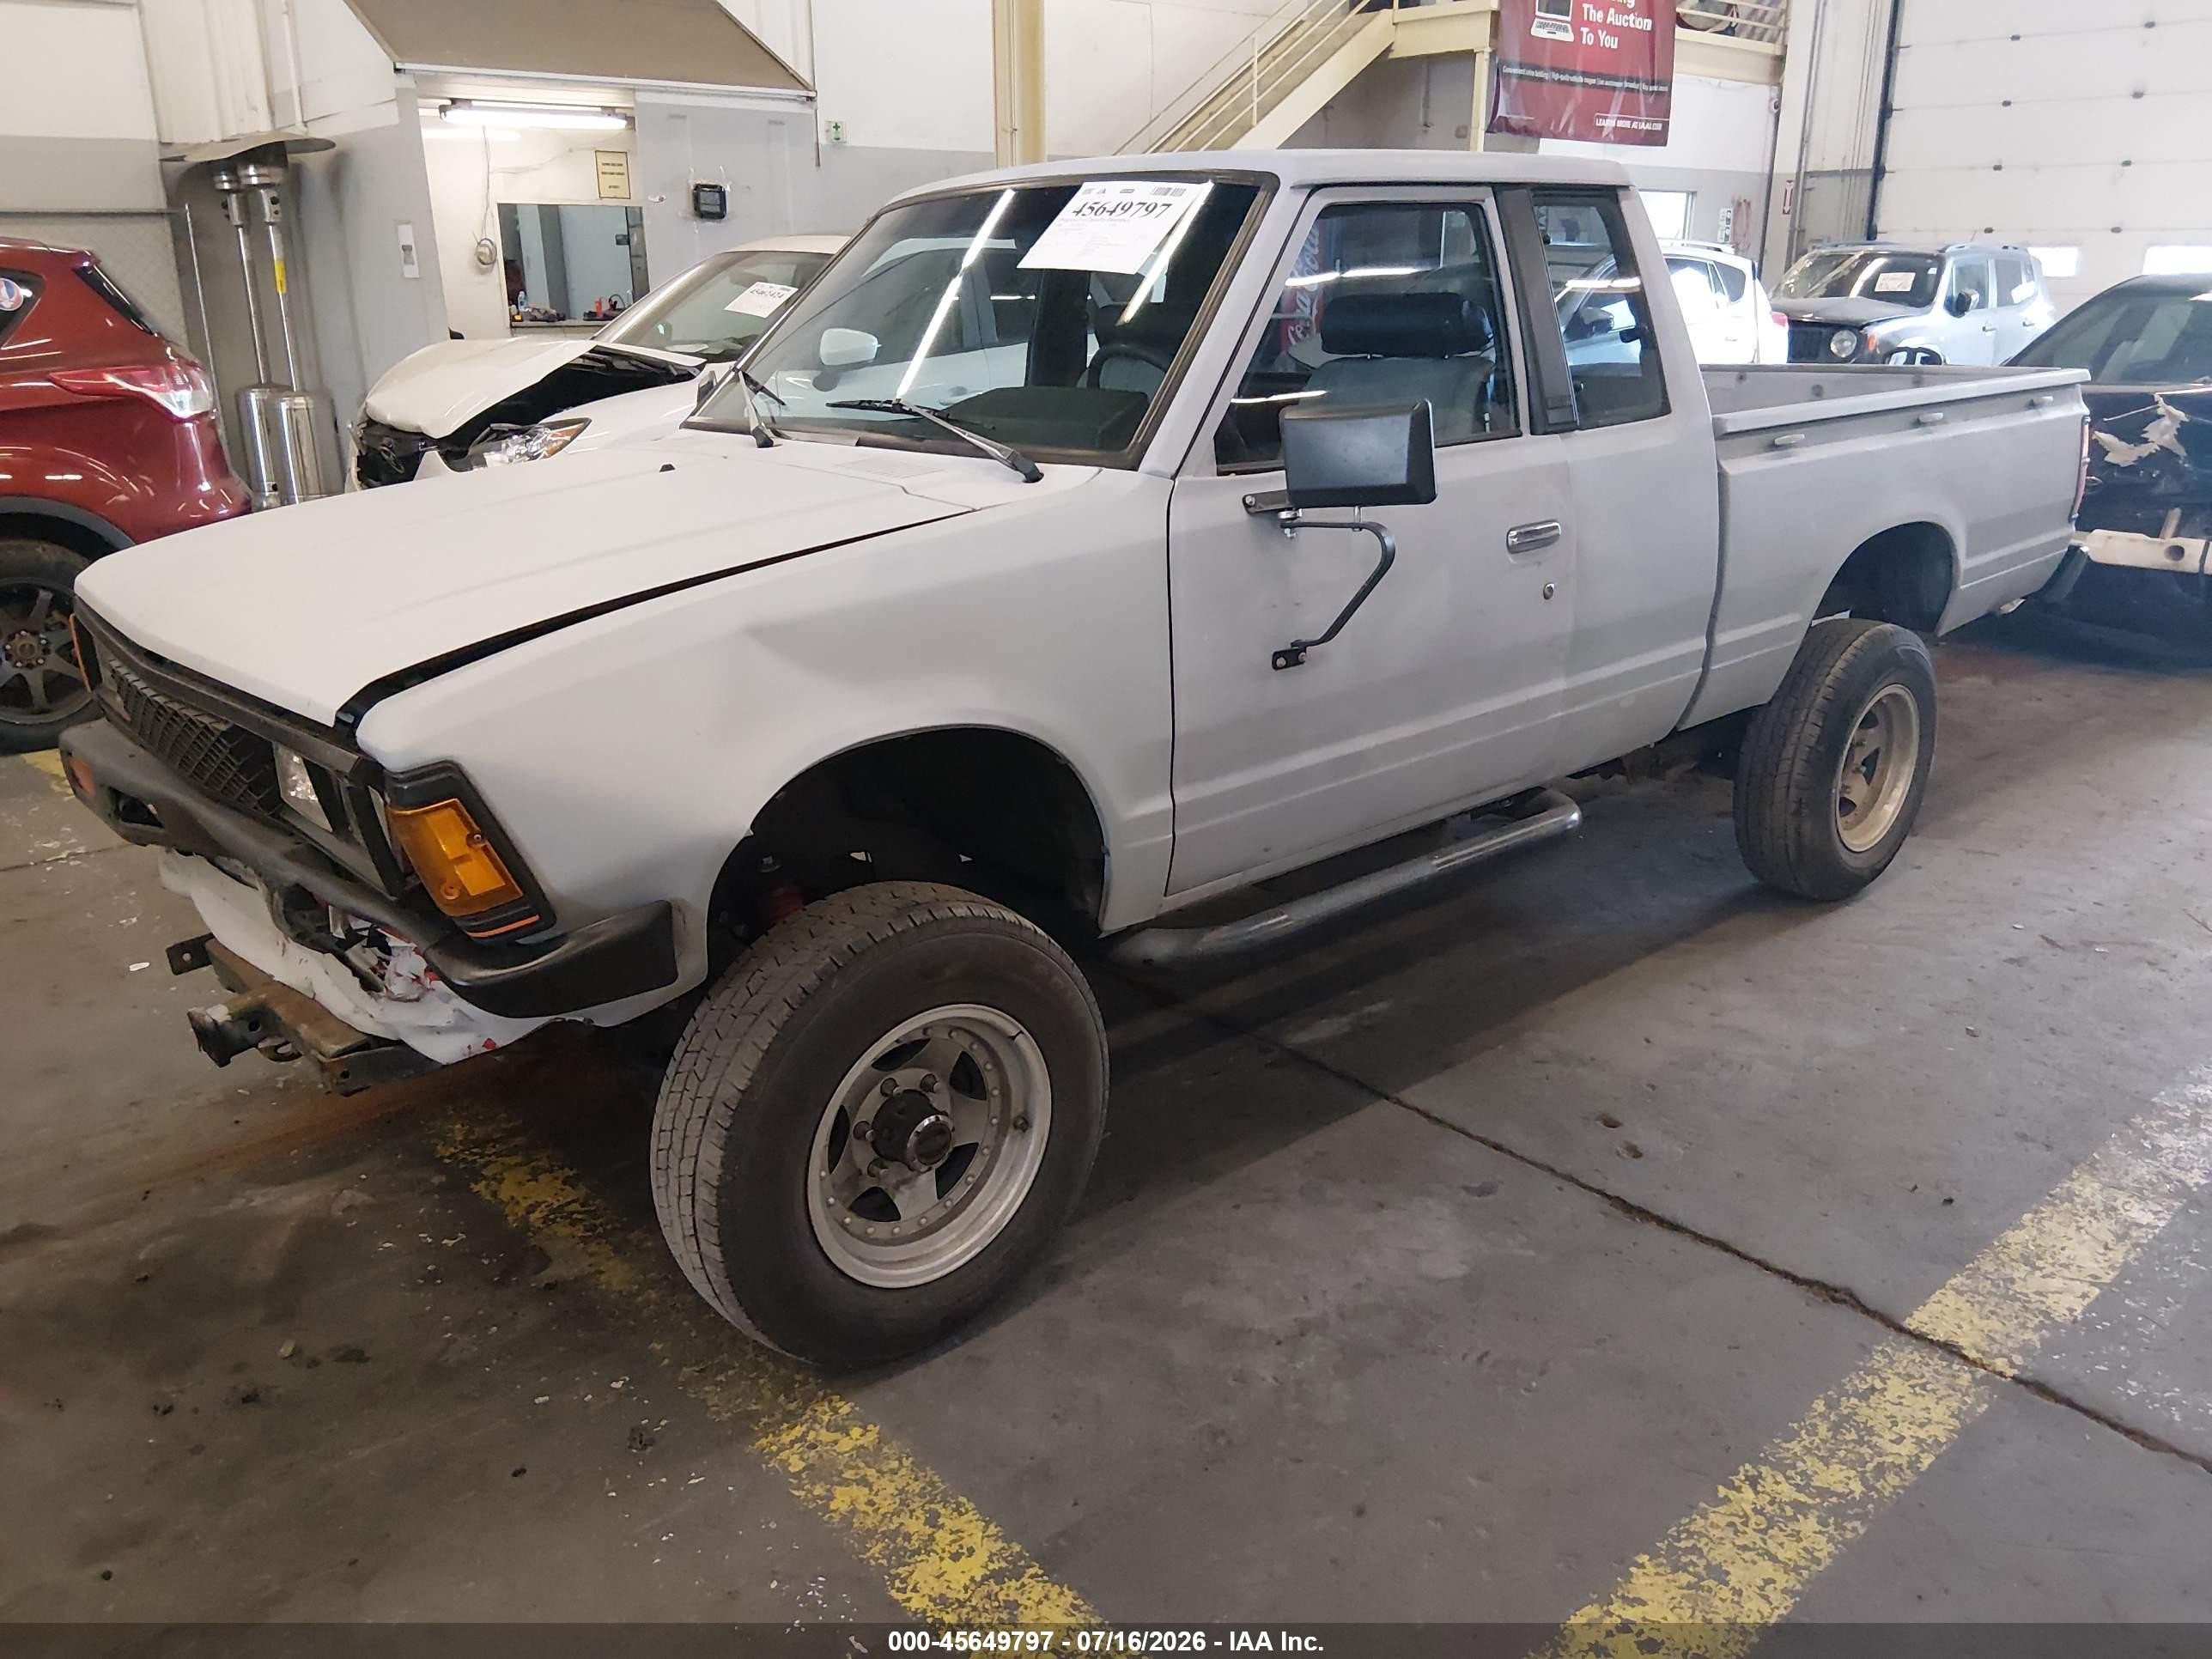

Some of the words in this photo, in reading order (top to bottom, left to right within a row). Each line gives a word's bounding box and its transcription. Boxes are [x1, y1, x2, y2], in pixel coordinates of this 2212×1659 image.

[1582, 3, 1604, 23] The
[1606, 8, 1652, 31] Auction
[1580, 27, 1595, 46] To
[1597, 29, 1619, 49] You
[1072, 201, 1174, 218] 45649797
